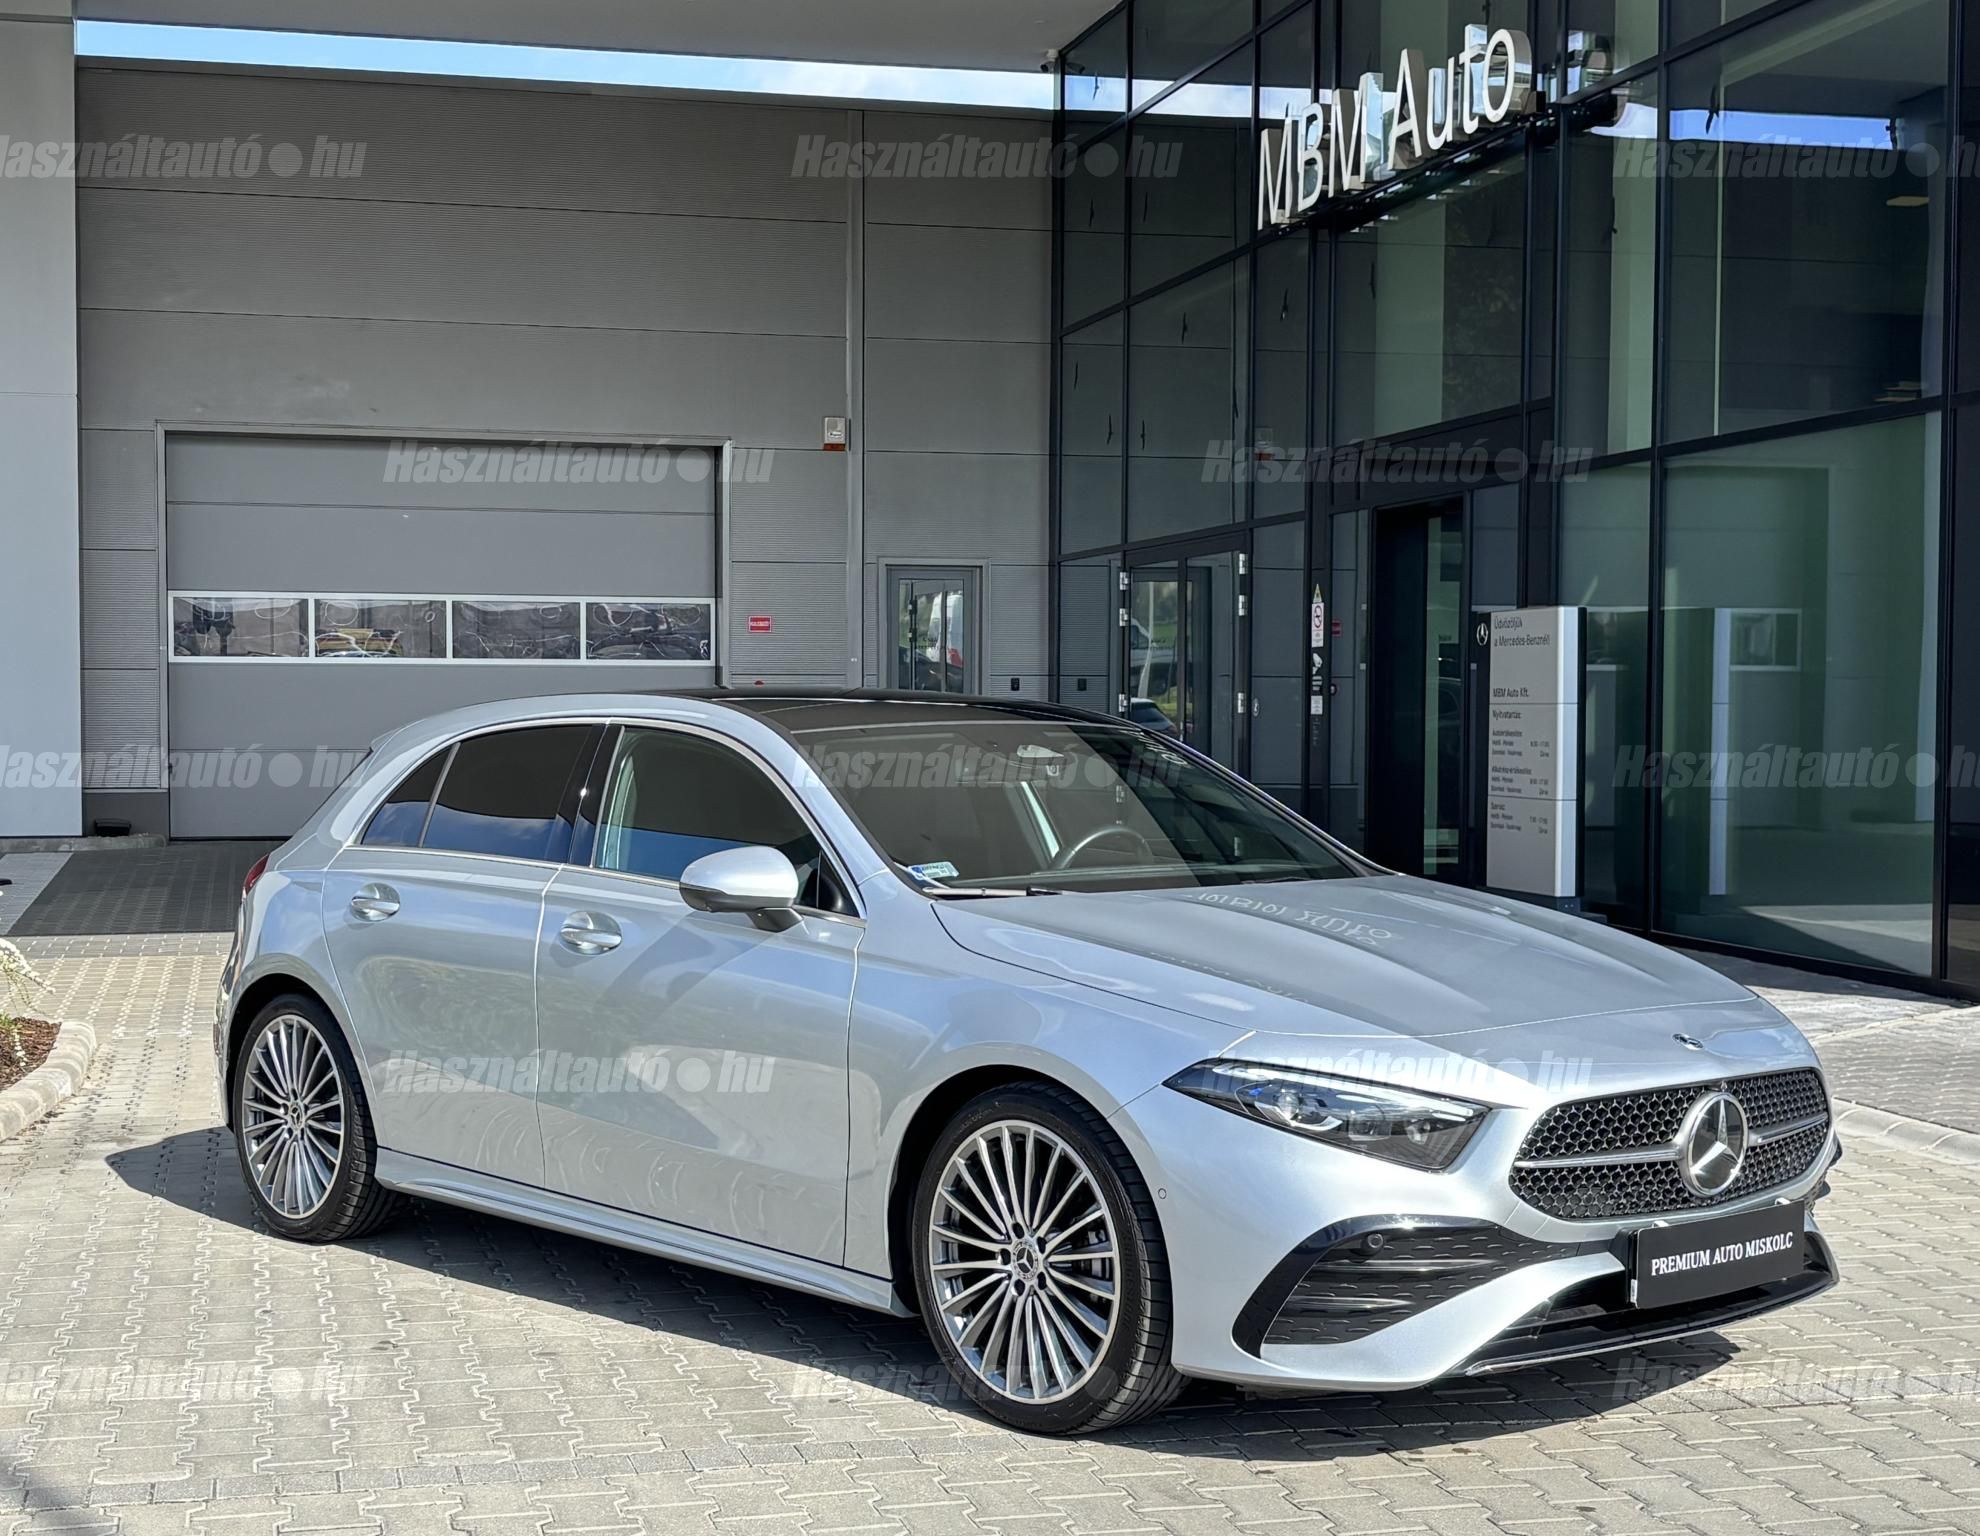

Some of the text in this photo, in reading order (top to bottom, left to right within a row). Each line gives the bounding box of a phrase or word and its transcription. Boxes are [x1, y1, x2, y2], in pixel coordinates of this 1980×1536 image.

[1257, 24, 1531, 231] MBM Auto
[1651, 1232, 1793, 1276] PREMIUM AUTO MISKOLC
